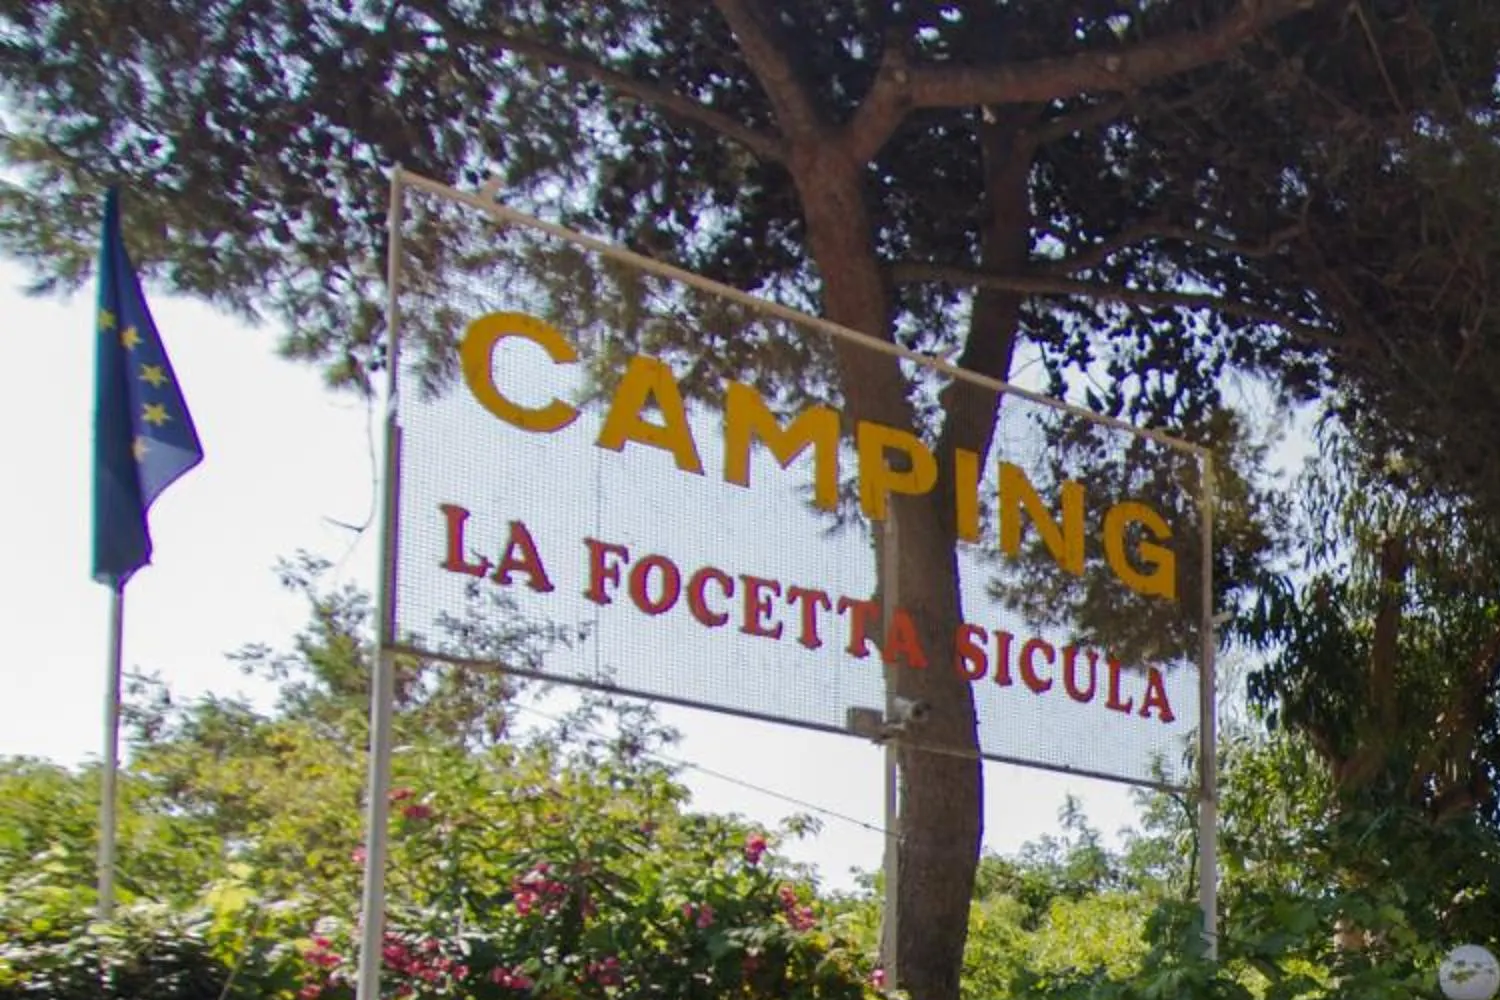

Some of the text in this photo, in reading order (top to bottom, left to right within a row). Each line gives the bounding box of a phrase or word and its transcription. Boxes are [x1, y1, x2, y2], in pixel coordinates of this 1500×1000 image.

[459, 311, 1179, 600] CAMPING
[439, 503, 1176, 723] LA FOCETTA SICULA
